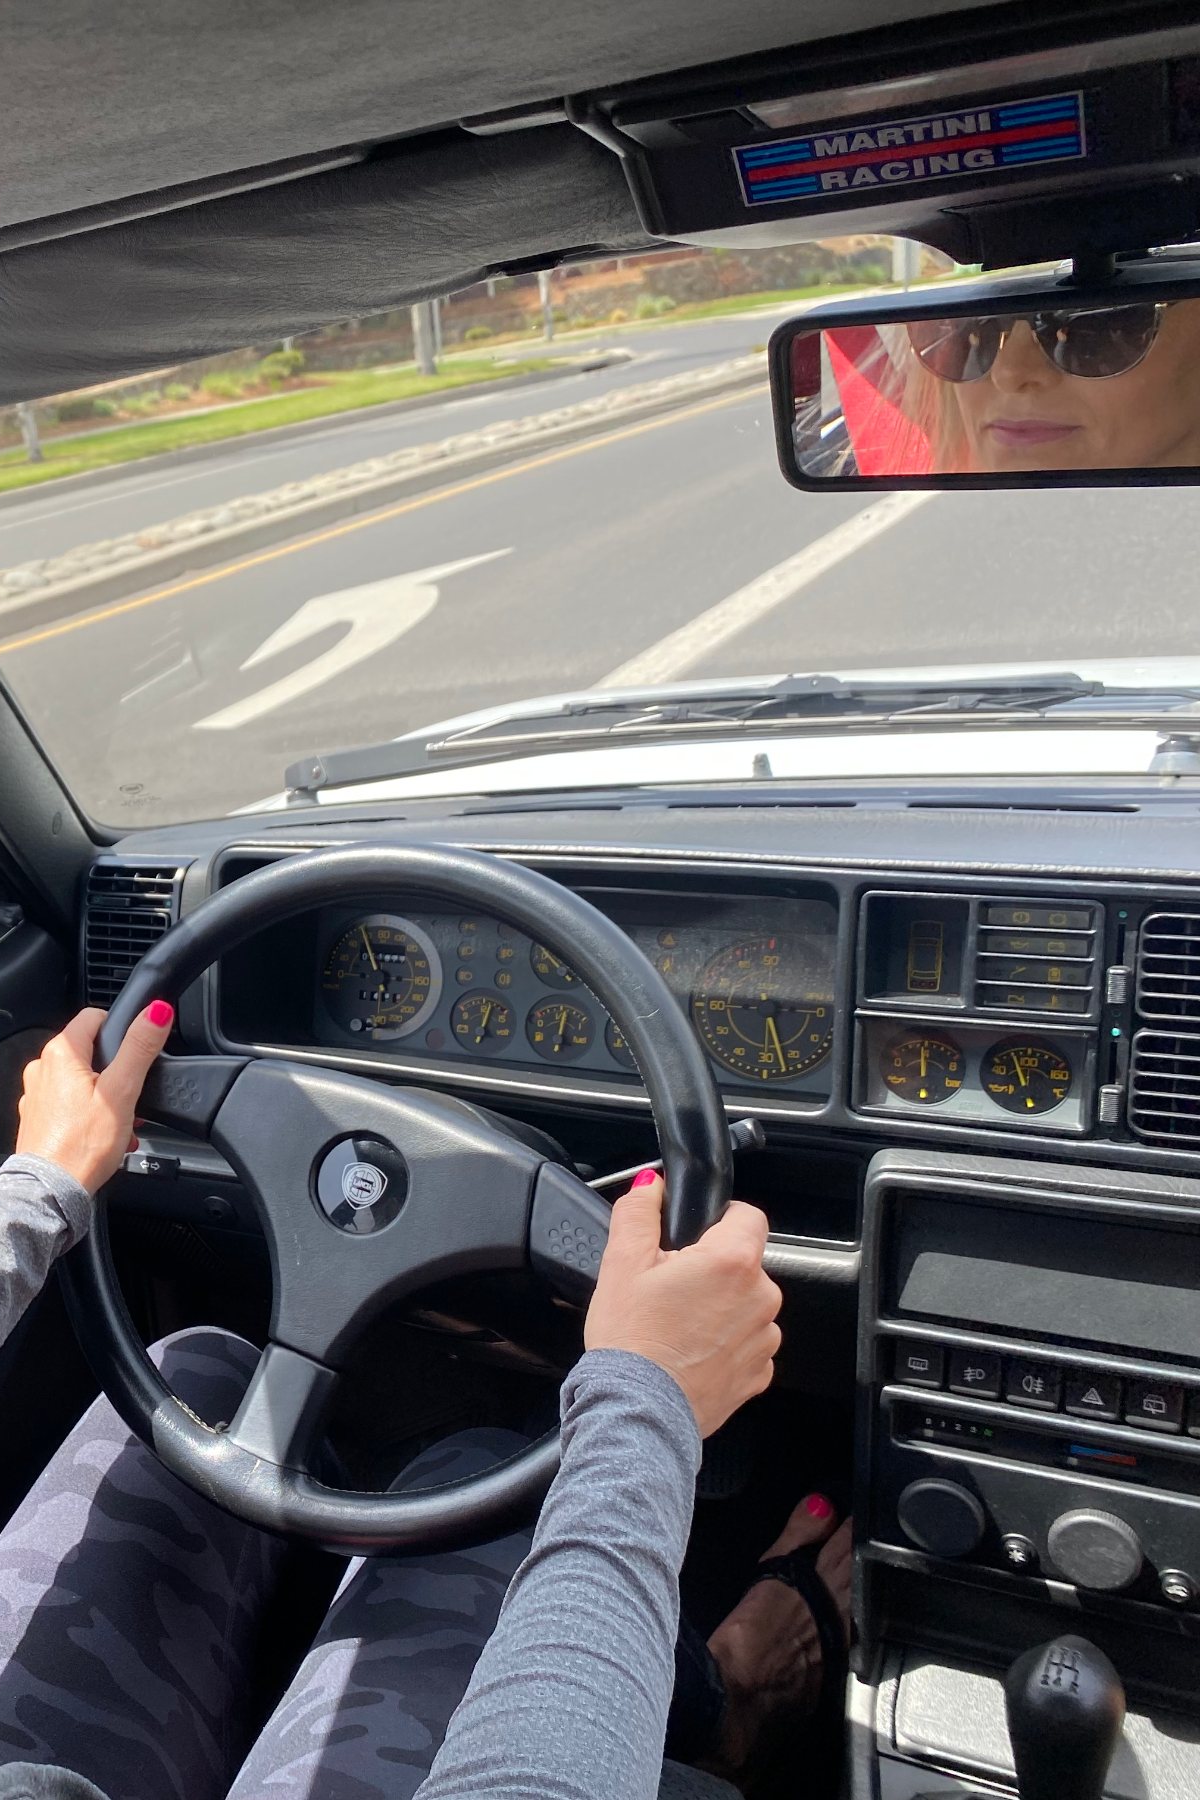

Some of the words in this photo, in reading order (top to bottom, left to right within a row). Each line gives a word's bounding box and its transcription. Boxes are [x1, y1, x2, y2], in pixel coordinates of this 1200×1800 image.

[814, 112, 991, 157] MARTINI
[820, 148, 995, 190] RACING
[709, 1000, 725, 1011] 60
[816, 1007, 825, 1018] 0
[758, 1052, 773, 1063] 30
[1019, 1056, 1039, 1067] 100
[992, 1065, 1006, 1075] 40
[1050, 1069, 1069, 1080] 160
[945, 1077, 961, 1088] bar
